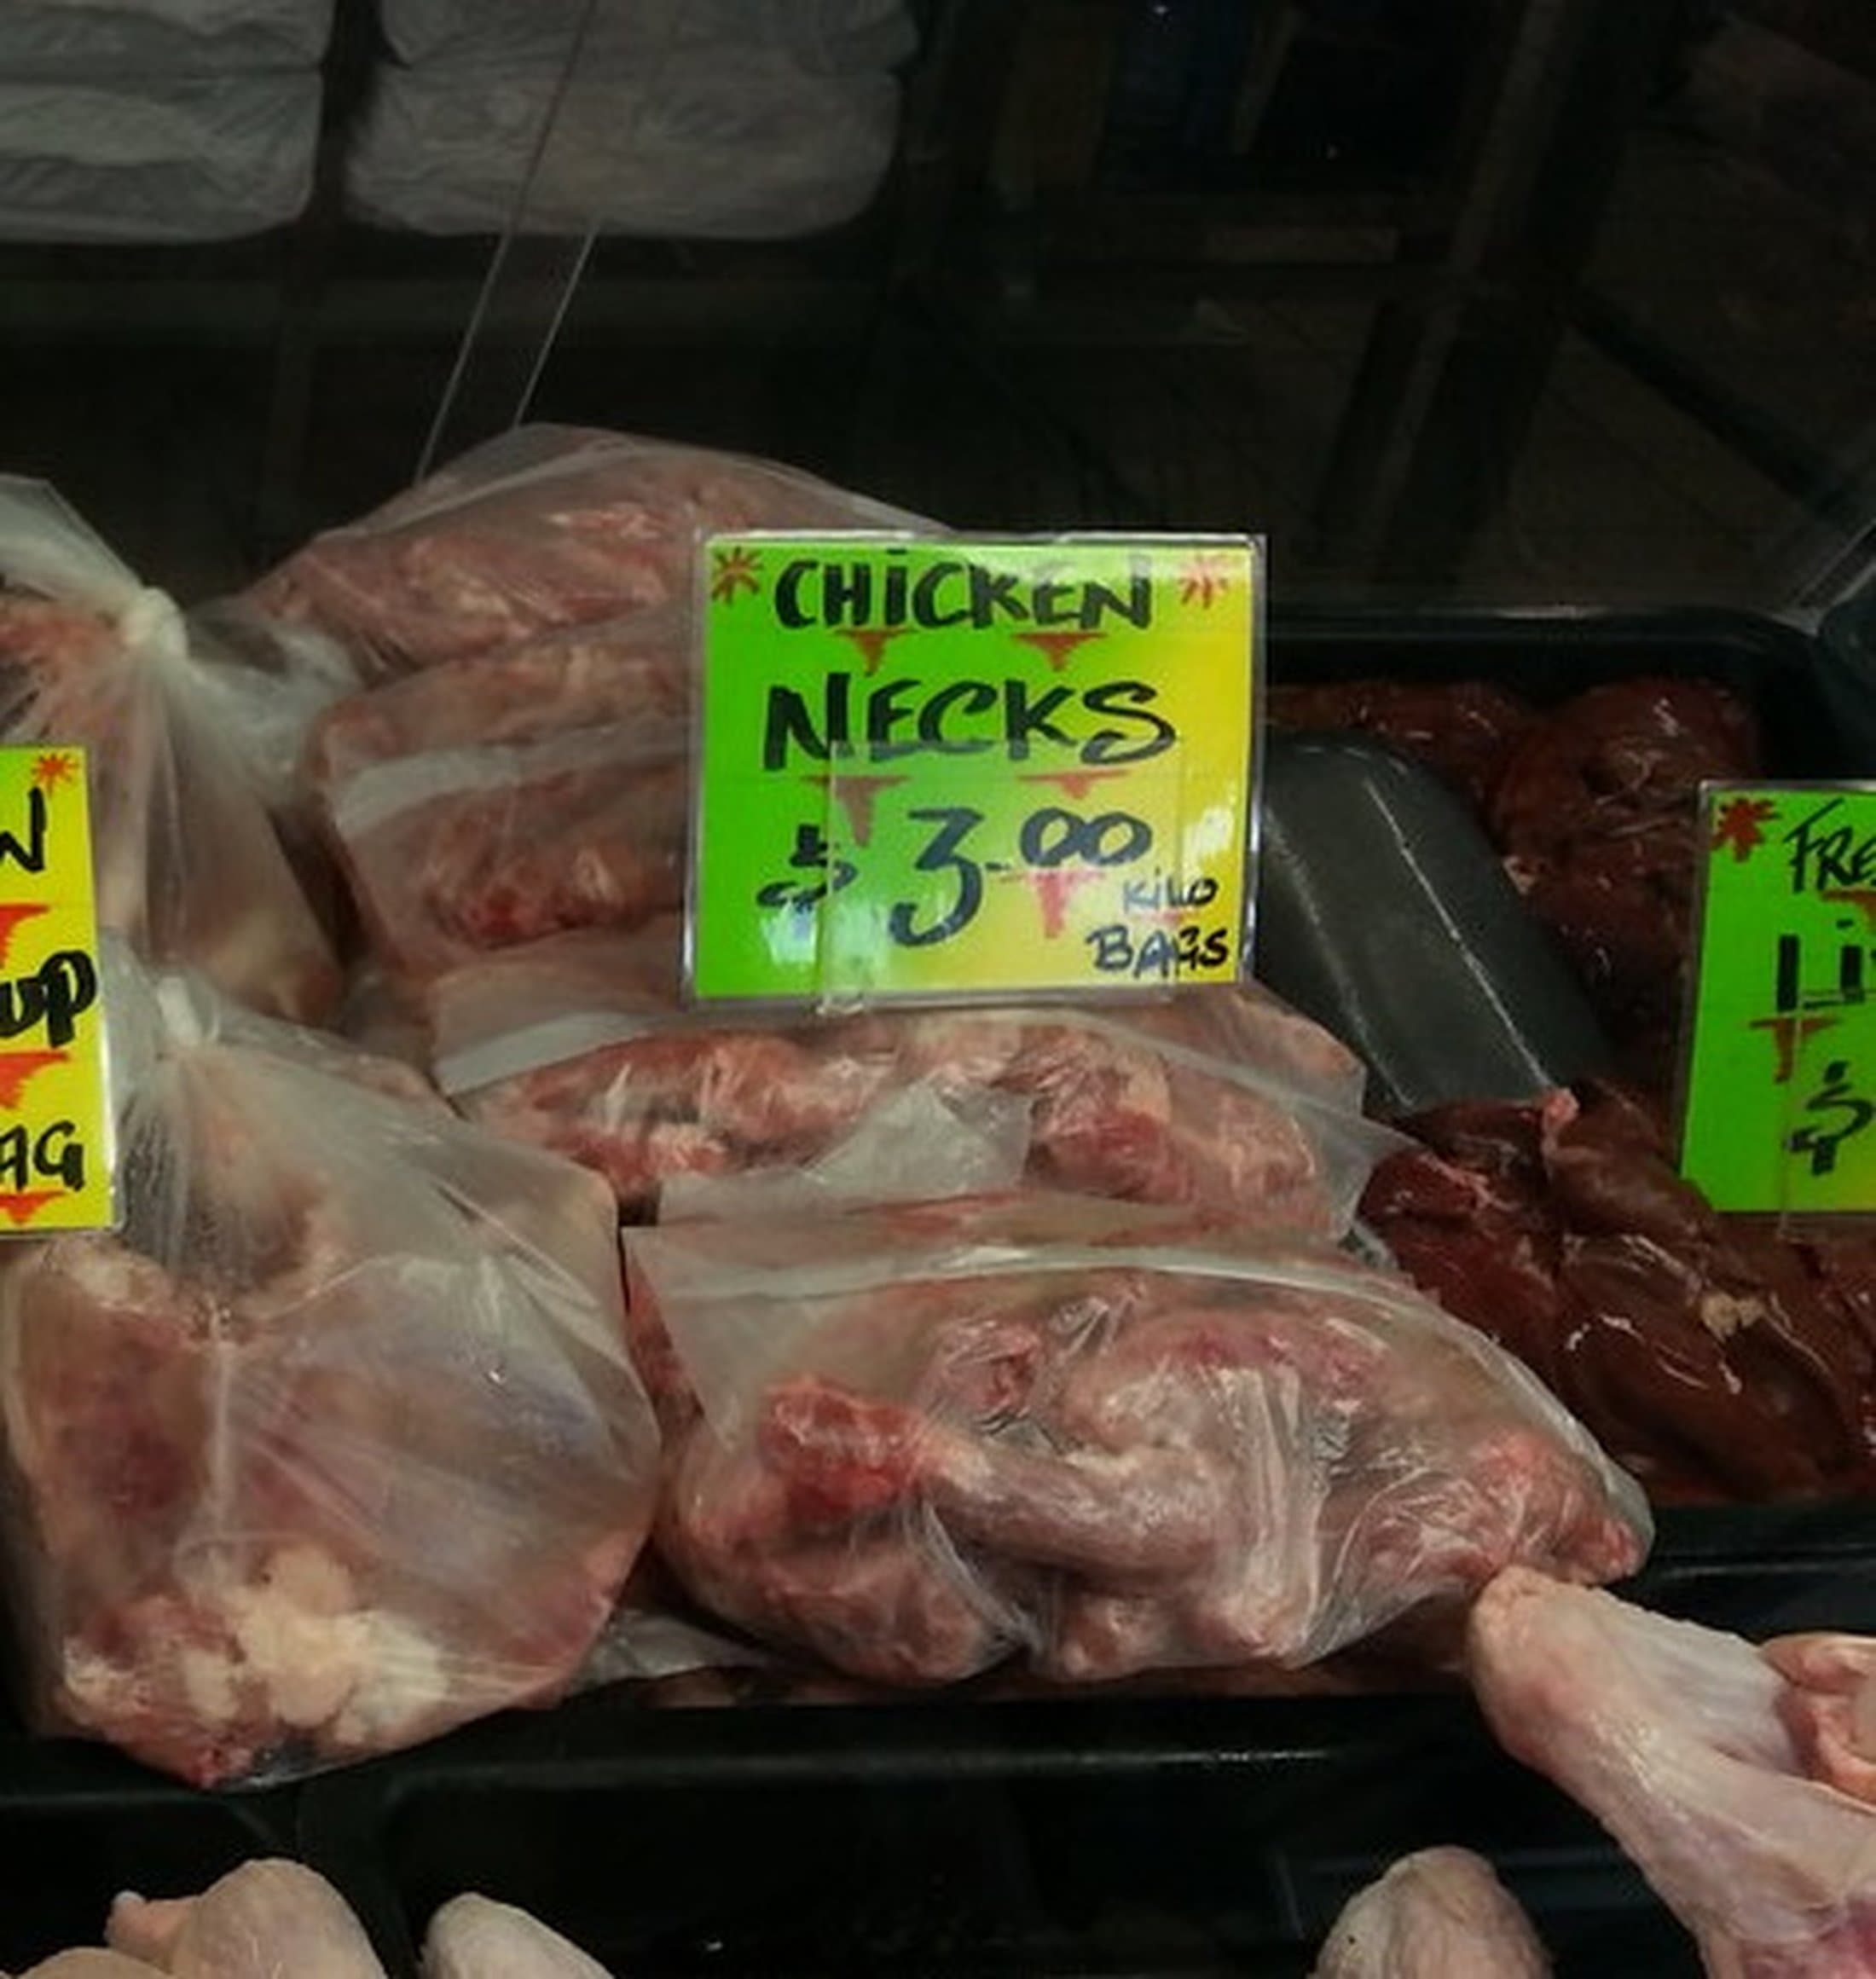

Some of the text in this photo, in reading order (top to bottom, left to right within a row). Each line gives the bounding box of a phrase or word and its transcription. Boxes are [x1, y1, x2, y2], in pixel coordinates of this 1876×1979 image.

[774, 549, 1152, 630] CHICKEN
[763, 672, 1175, 771] NECKS
[1782, 796, 1876, 894] FRE
[1086, 924, 1229, 979] BAGS
